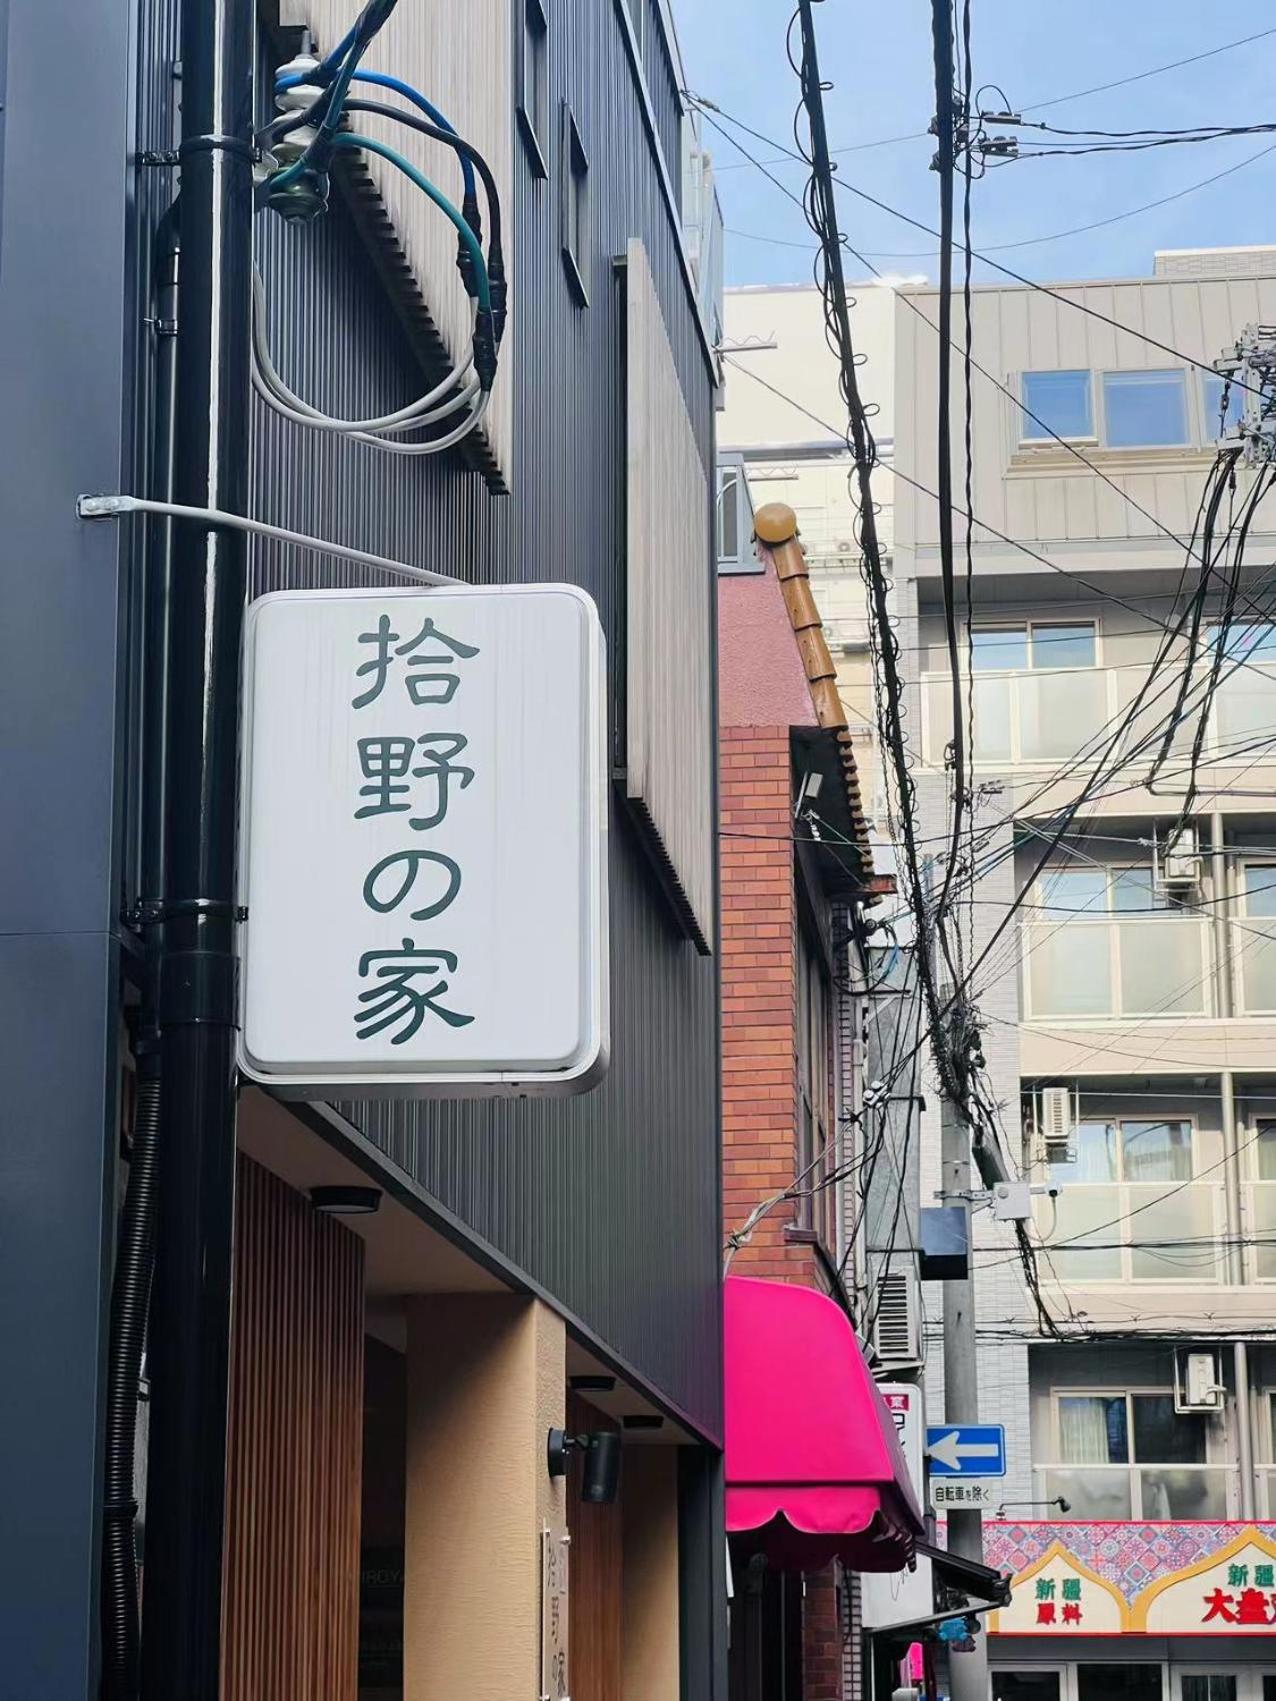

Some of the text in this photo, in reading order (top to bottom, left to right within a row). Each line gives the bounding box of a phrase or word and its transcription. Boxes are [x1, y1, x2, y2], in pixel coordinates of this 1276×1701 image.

[351, 614, 480, 1045] 拾野の家
[935, 1485, 989, 1501] 自転車を除く
[1228, 1563, 1275, 1587] 新疆
[1035, 1578, 1082, 1601] 新疆
[1201, 1587, 1276, 1625] 大盘
